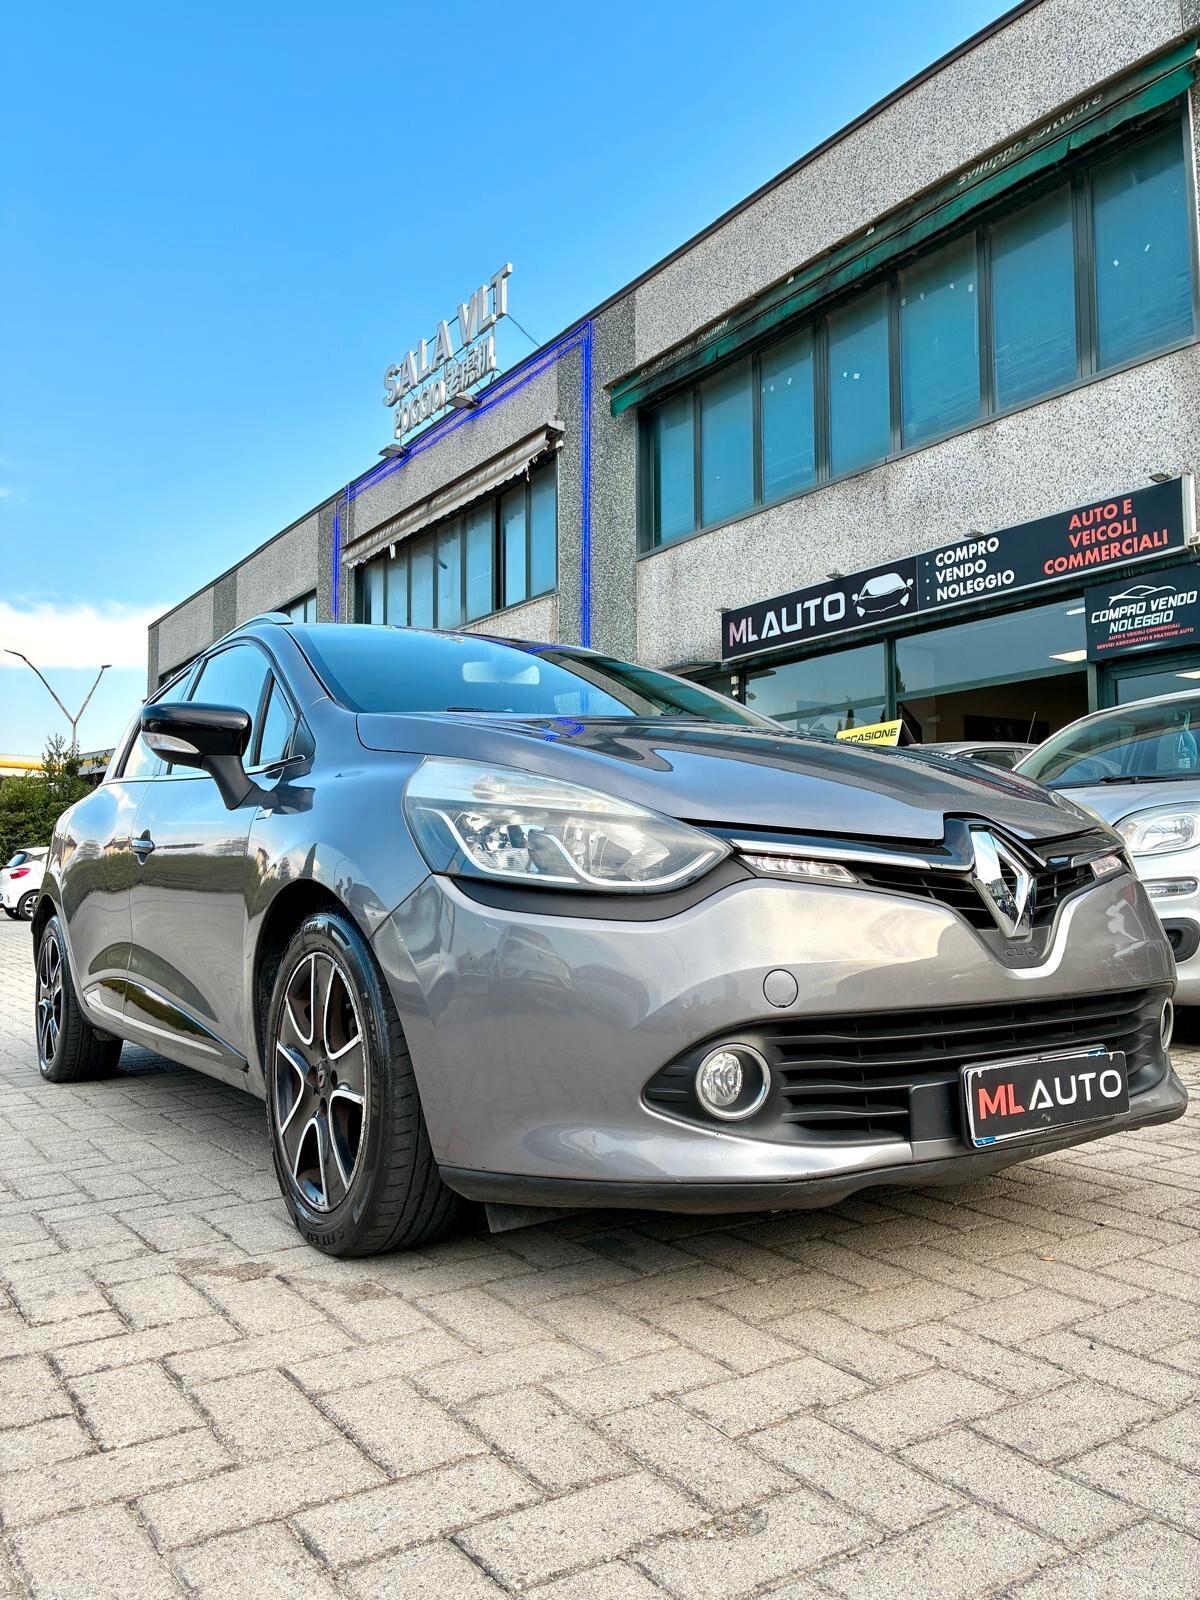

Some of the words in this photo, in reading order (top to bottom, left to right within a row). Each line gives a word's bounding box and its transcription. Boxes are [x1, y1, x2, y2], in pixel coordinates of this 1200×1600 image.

[383, 320, 453, 407] SALA
[456, 262, 513, 346] VLT
[1069, 504, 1117, 530] AUTO
[1123, 498, 1132, 515] E
[1068, 517, 1137, 549] VEICOLI
[935, 537, 1000, 567] COMPRO
[1043, 529, 1168, 575] COMMERCIALI
[935, 558, 987, 585] VENDO
[936, 569, 1015, 603] NOLEGGIO
[729, 620, 758, 648] ML
[762, 592, 846, 638] AUTO
[1091, 602, 1146, 624] COMPRO
[1150, 590, 1198, 612] VENDO
[1109, 610, 1174, 633] NOLEGGIO
[1115, 636, 1149, 646] ASSICURATIVI
[1153, 630, 1179, 640] PRATICHE
[1179, 627, 1194, 635] AUTO
[1127, 629, 1146, 638] VEICOLI
[1146, 623, 1180, 633] COMMERCIALI
[1005, 945, 1038, 957] CLIO
[977, 1083, 1025, 1120] ML
[1028, 1069, 1122, 1111] AUTO
